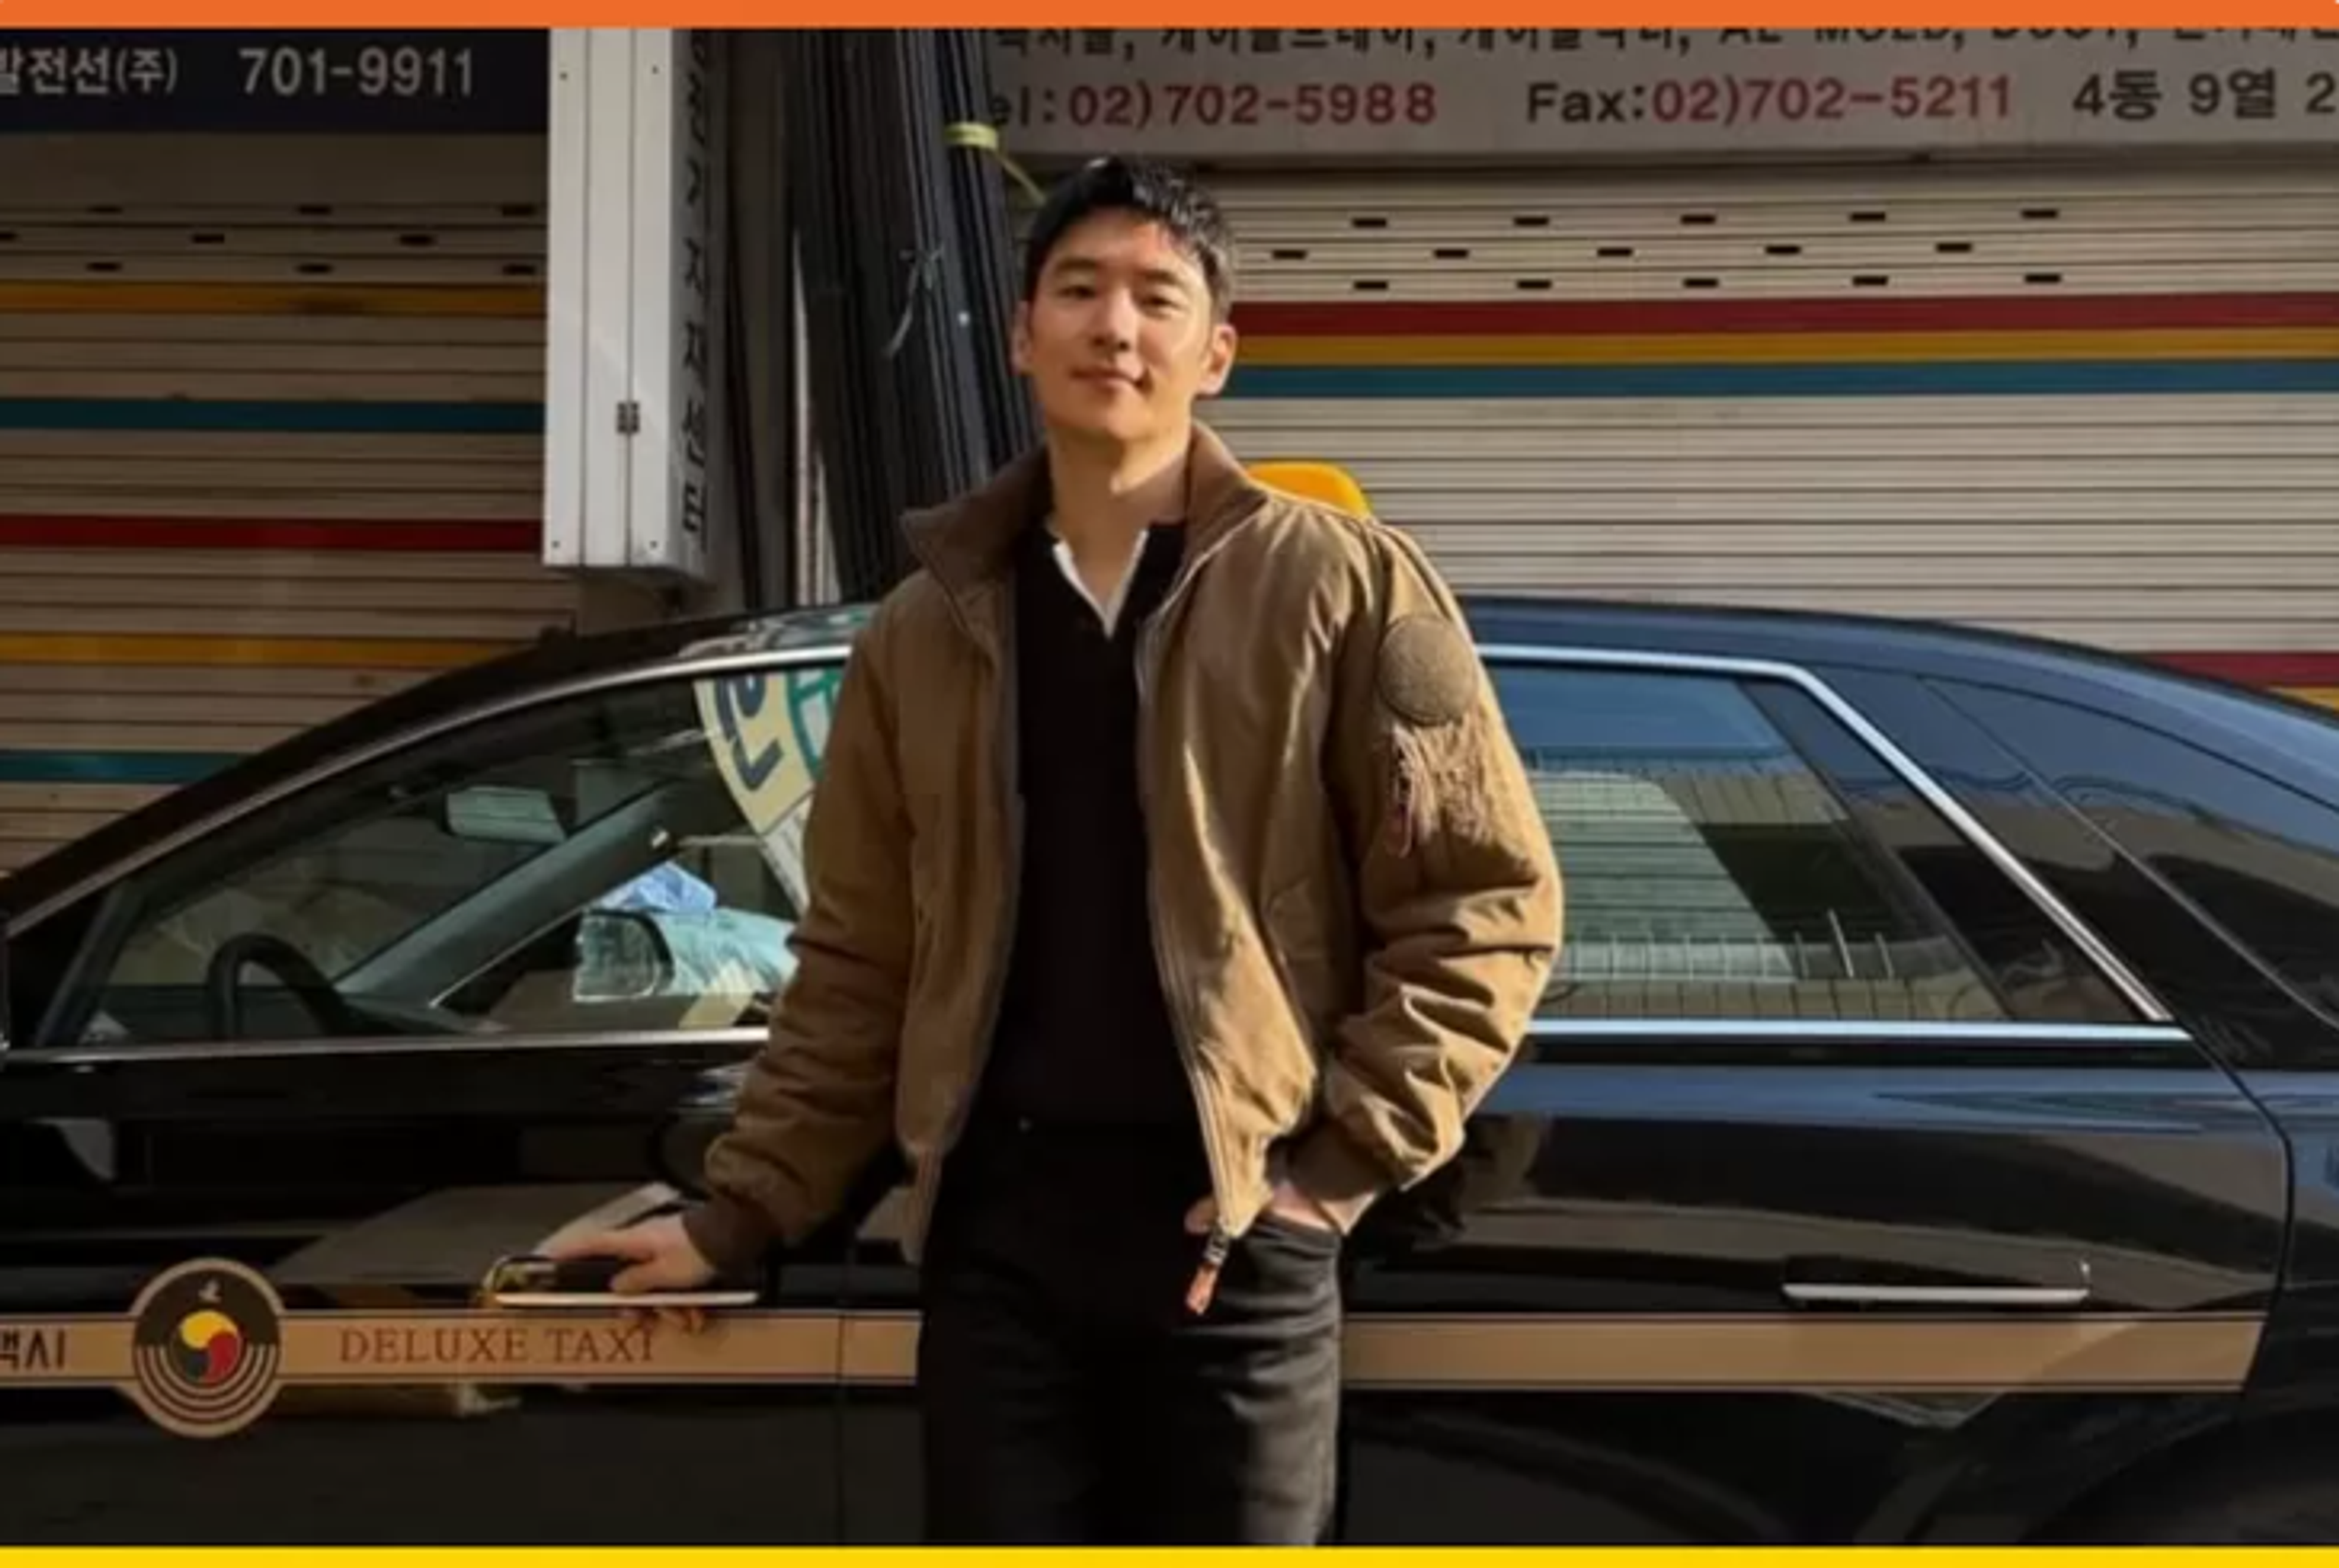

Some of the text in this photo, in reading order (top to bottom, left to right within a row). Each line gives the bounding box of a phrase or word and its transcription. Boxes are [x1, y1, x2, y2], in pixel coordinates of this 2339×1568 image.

[240, 47, 473, 96] 701-9911
[1527, 72, 2011, 125] Fax:02)702-5211
[2072, 69, 2162, 122] 4동
[2189, 68, 2276, 119] 9열
[2305, 72, 2336, 114] 2
[339, 1324, 655, 1363] DELUXE TAXI
